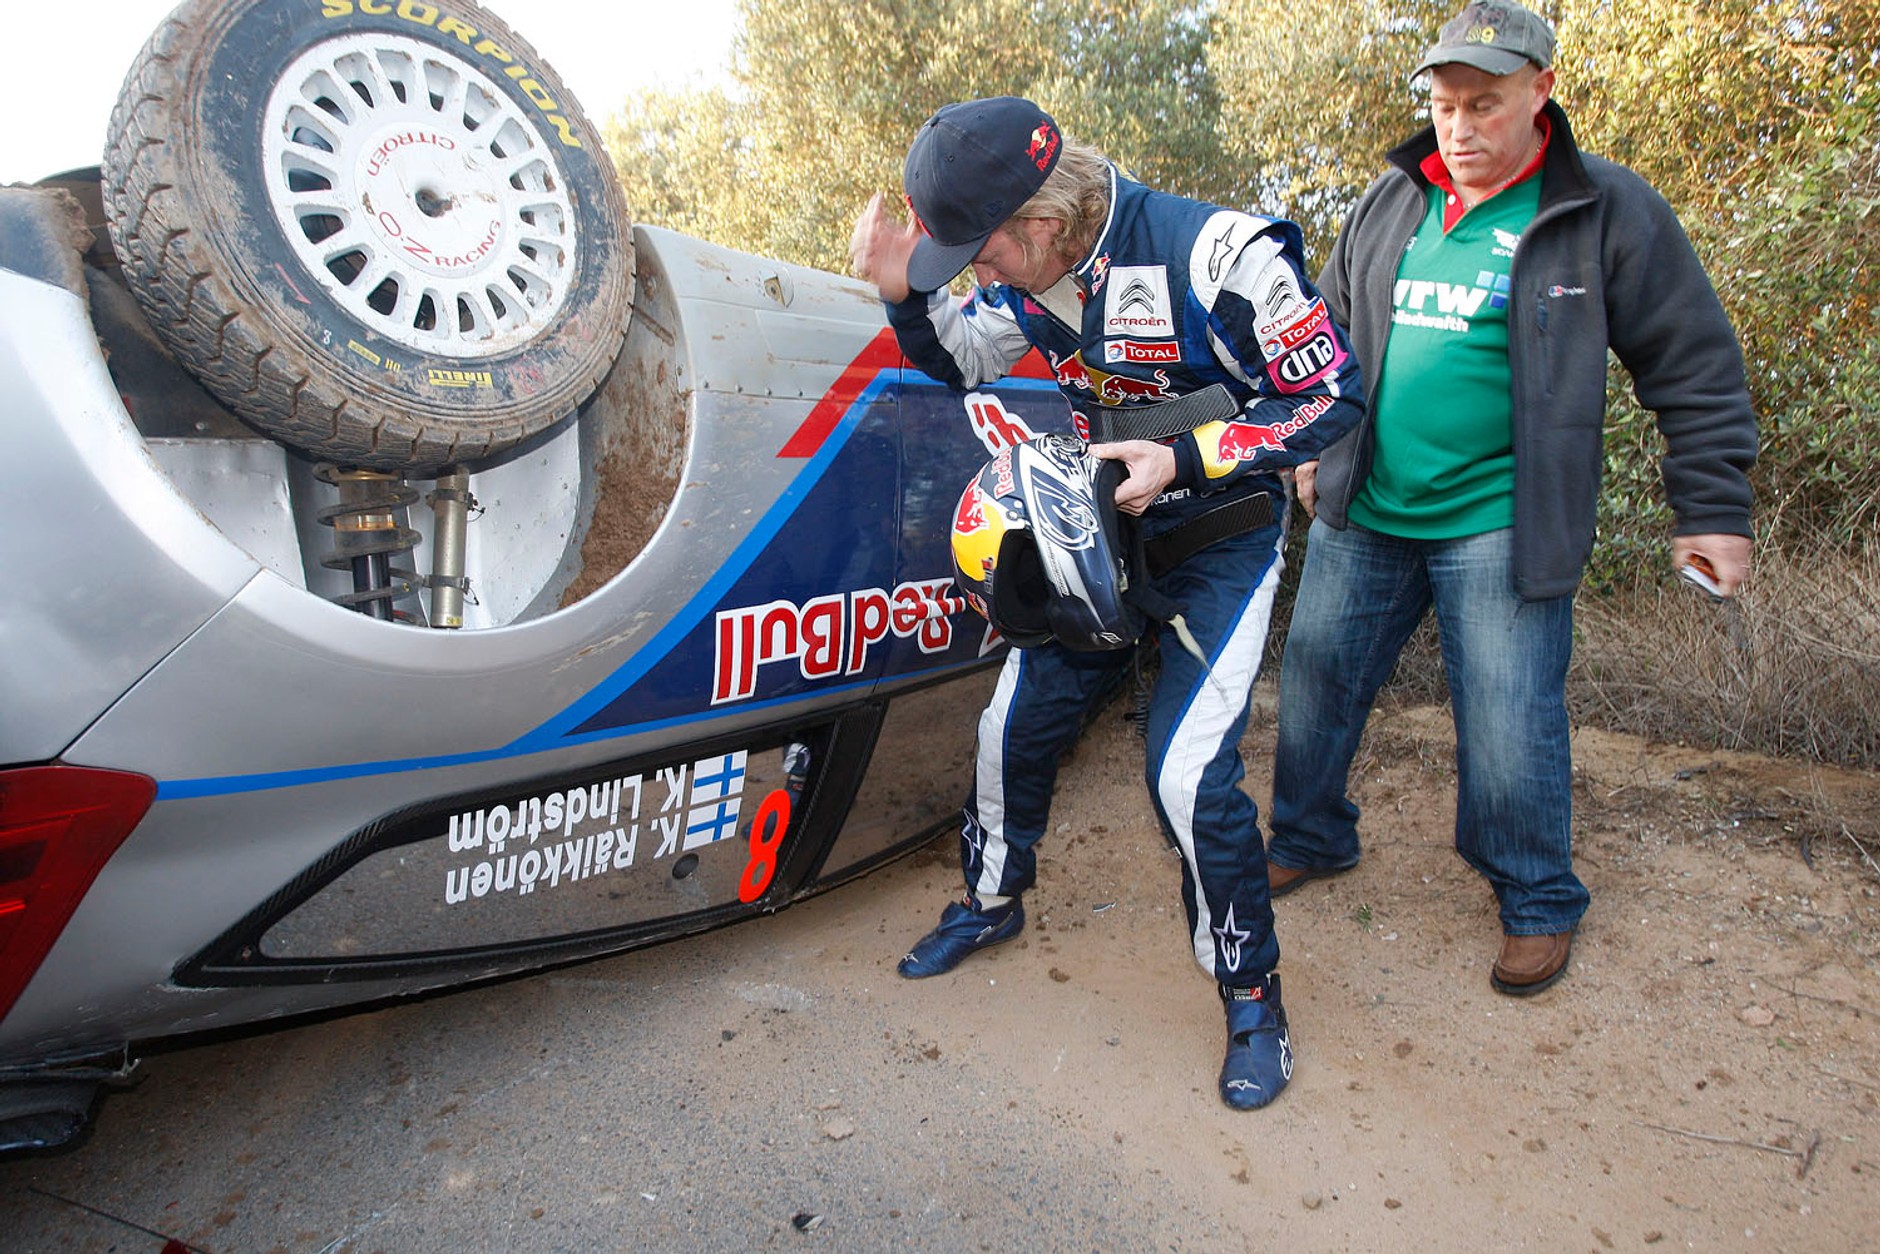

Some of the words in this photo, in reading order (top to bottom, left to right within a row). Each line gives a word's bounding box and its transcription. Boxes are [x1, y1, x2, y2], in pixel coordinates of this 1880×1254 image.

[321, 0, 582, 148] SCORPION
[435, 220, 501, 266] RACING
[1282, 308, 1326, 343] TOTAL
[1127, 345, 1177, 358] TOTAL
[428, 369, 492, 387] PIRELLI
[1270, 409, 1309, 440] Red
[1302, 395, 1335, 421] Bull
[711, 593, 845, 706] Bull
[846, 578, 955, 676] Red
[656, 764, 687, 811] K.
[448, 774, 643, 853] Lindström
[650, 812, 684, 860] K.
[445, 824, 638, 904] Räikkönen
[738, 789, 791, 903] 8
